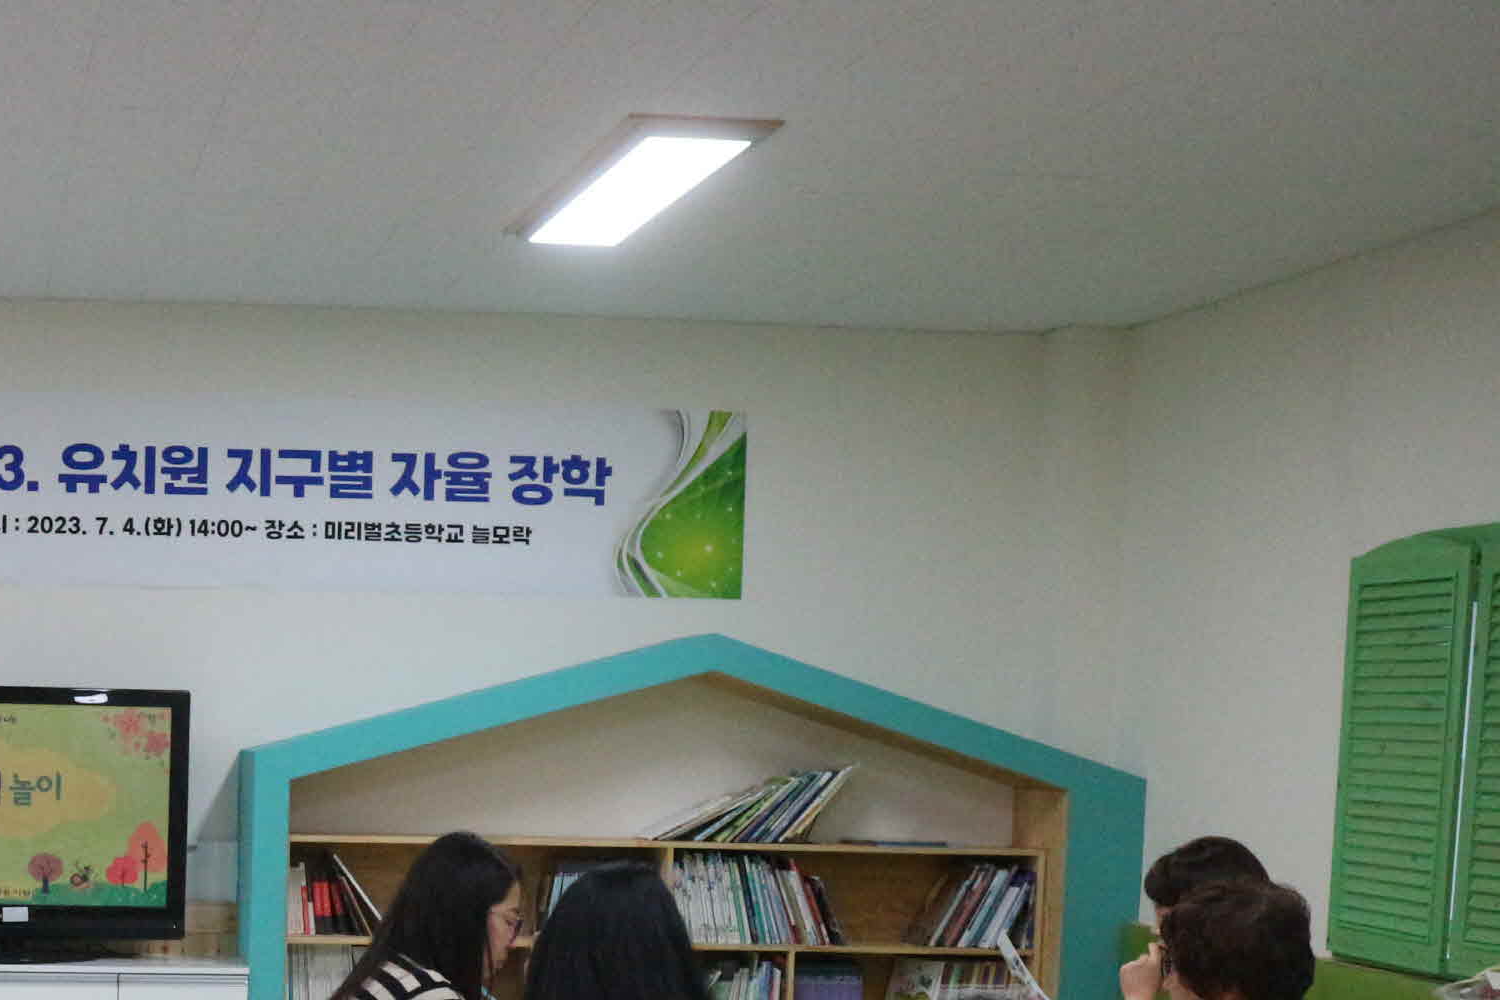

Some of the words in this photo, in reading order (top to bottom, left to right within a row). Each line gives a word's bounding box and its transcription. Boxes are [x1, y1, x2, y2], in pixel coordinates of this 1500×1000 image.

[58, 443, 209, 495] 유치원
[226, 448, 373, 499] 지구별
[389, 452, 493, 502] 자율
[508, 455, 613, 506] 장학
[27, 516, 87, 535] 2023.
[95, 517, 114, 535] 7.
[264, 519, 305, 540] 장소
[324, 521, 465, 543] 미리벌초등학교
[472, 525, 532, 545] 늘모락
[8, 772, 63, 806] 놀이
